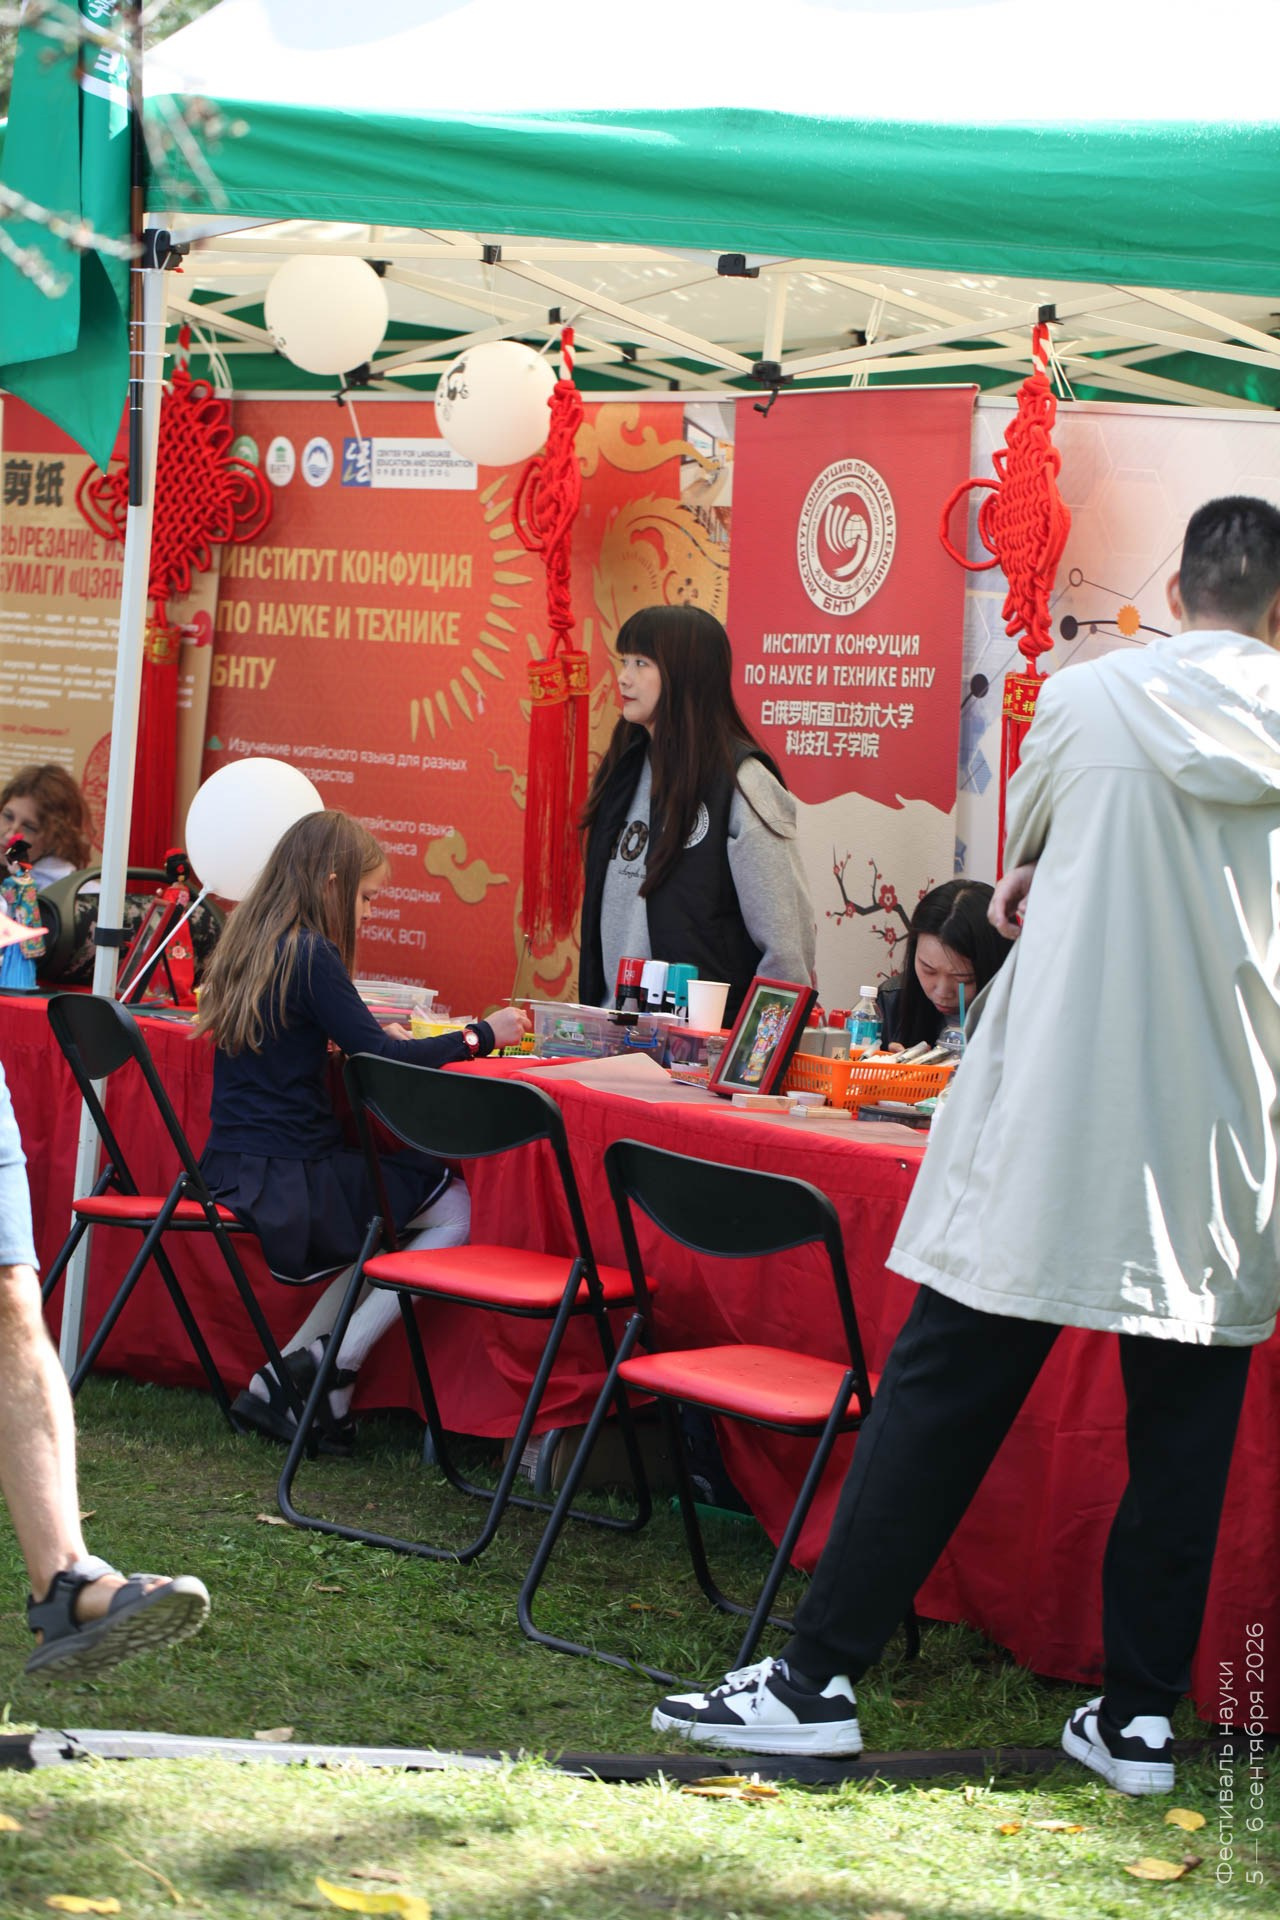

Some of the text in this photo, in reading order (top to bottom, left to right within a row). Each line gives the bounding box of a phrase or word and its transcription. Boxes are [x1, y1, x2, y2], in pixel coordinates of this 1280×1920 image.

[3, 459, 65, 507] 剪纸
[221, 546, 473, 593] ИНСТИТУТ КОНФУЦИЯ
[822, 596, 857, 613] БНТУ
[215, 600, 461, 646] ПО НАУКЕ И ТЕХНИКЕ
[762, 633, 920, 658] ИНСТИТУТ КОНФУЦИЯ
[211, 653, 277, 690] БНТУ
[744, 664, 936, 689] ПО НАУКЕ И ТЕХНИКЕ БНТУ
[761, 699, 914, 729] 白俄罗斯国立技术大学
[228, 736, 468, 771] Изучение китайского языка для разных
[785, 730, 880, 758] 科技孔子学院
[419, 822, 455, 838] языка
